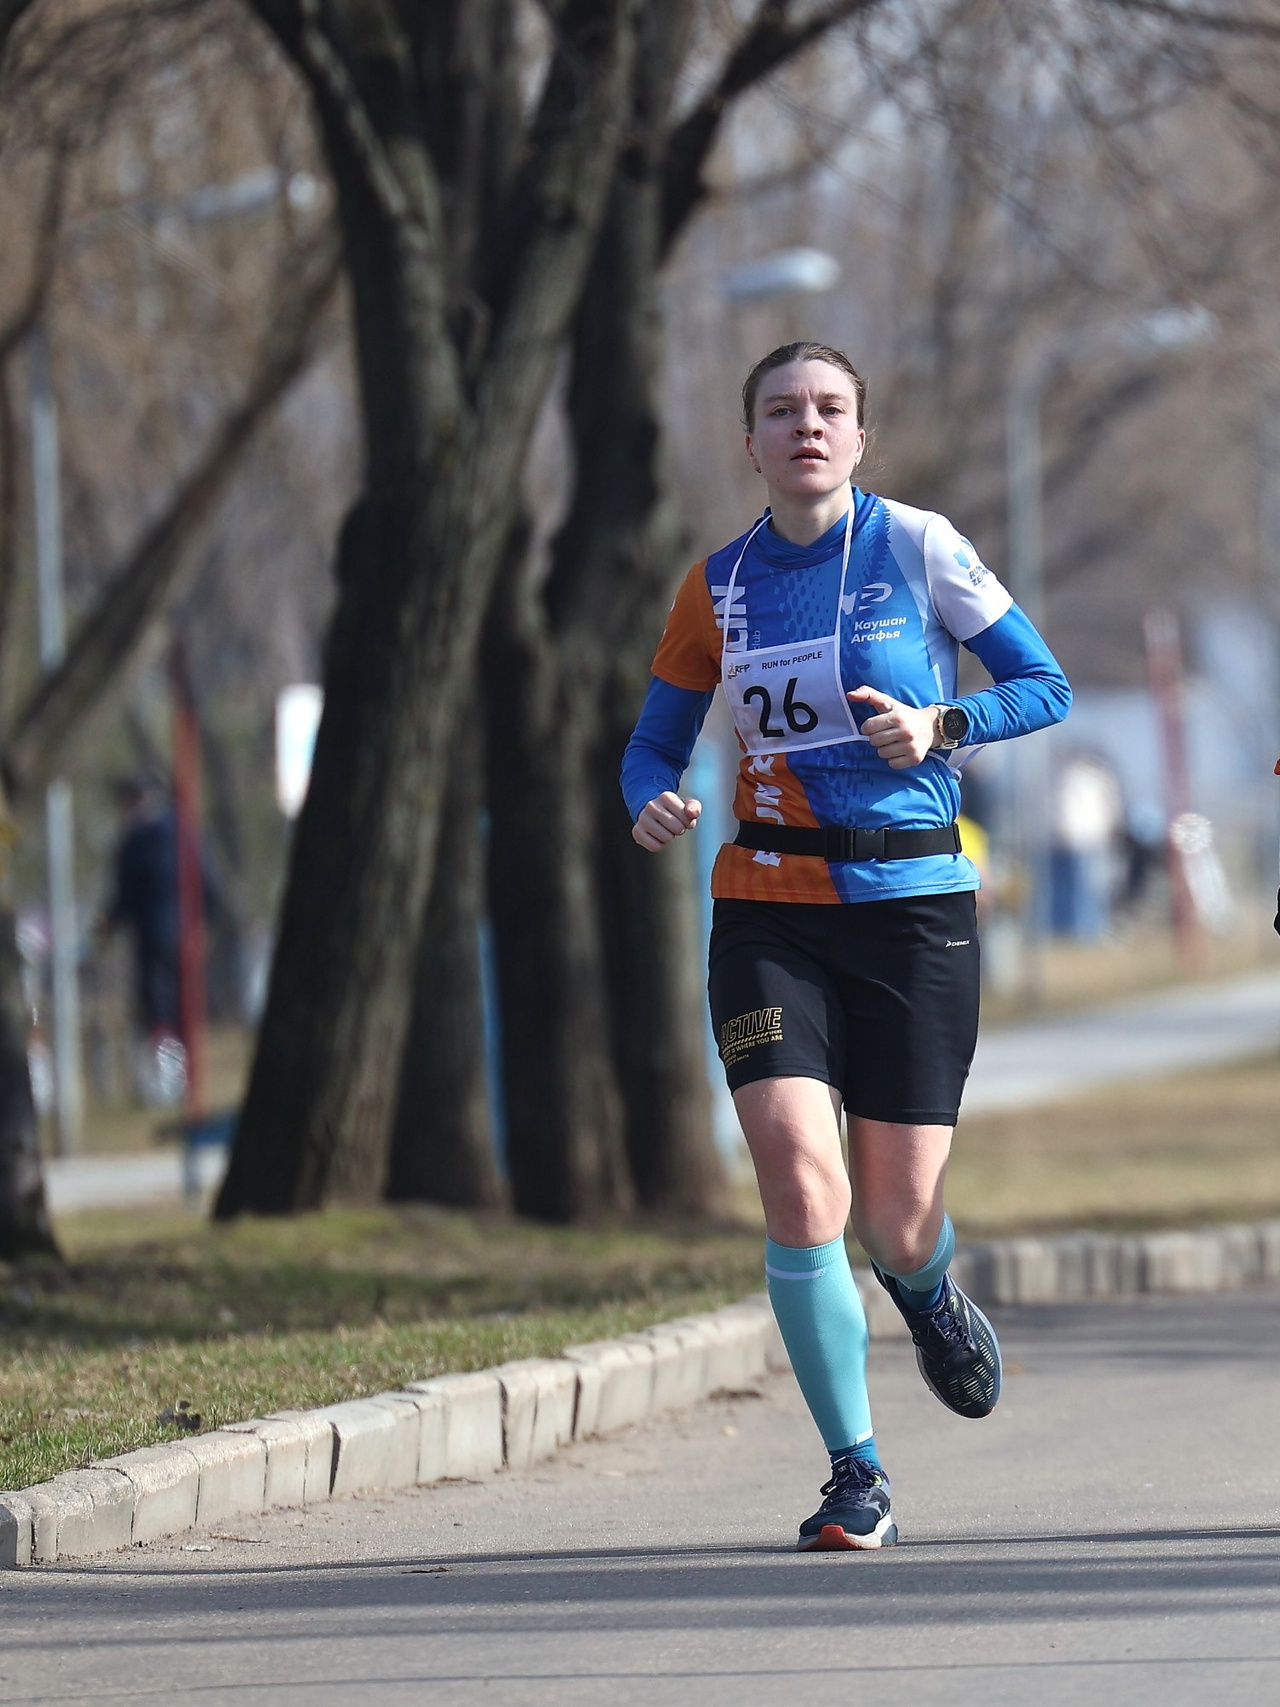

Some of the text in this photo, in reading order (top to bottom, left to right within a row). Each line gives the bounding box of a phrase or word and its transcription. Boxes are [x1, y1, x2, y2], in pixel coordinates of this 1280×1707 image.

[854, 615, 907, 632] Каушан
[850, 629, 901, 644] Агафья
[761, 650, 823, 671] RUN for PEOPLE
[743, 677, 819, 738] 26
[756, 1037, 770, 1045] YOU
[770, 1034, 784, 1042] ARE
